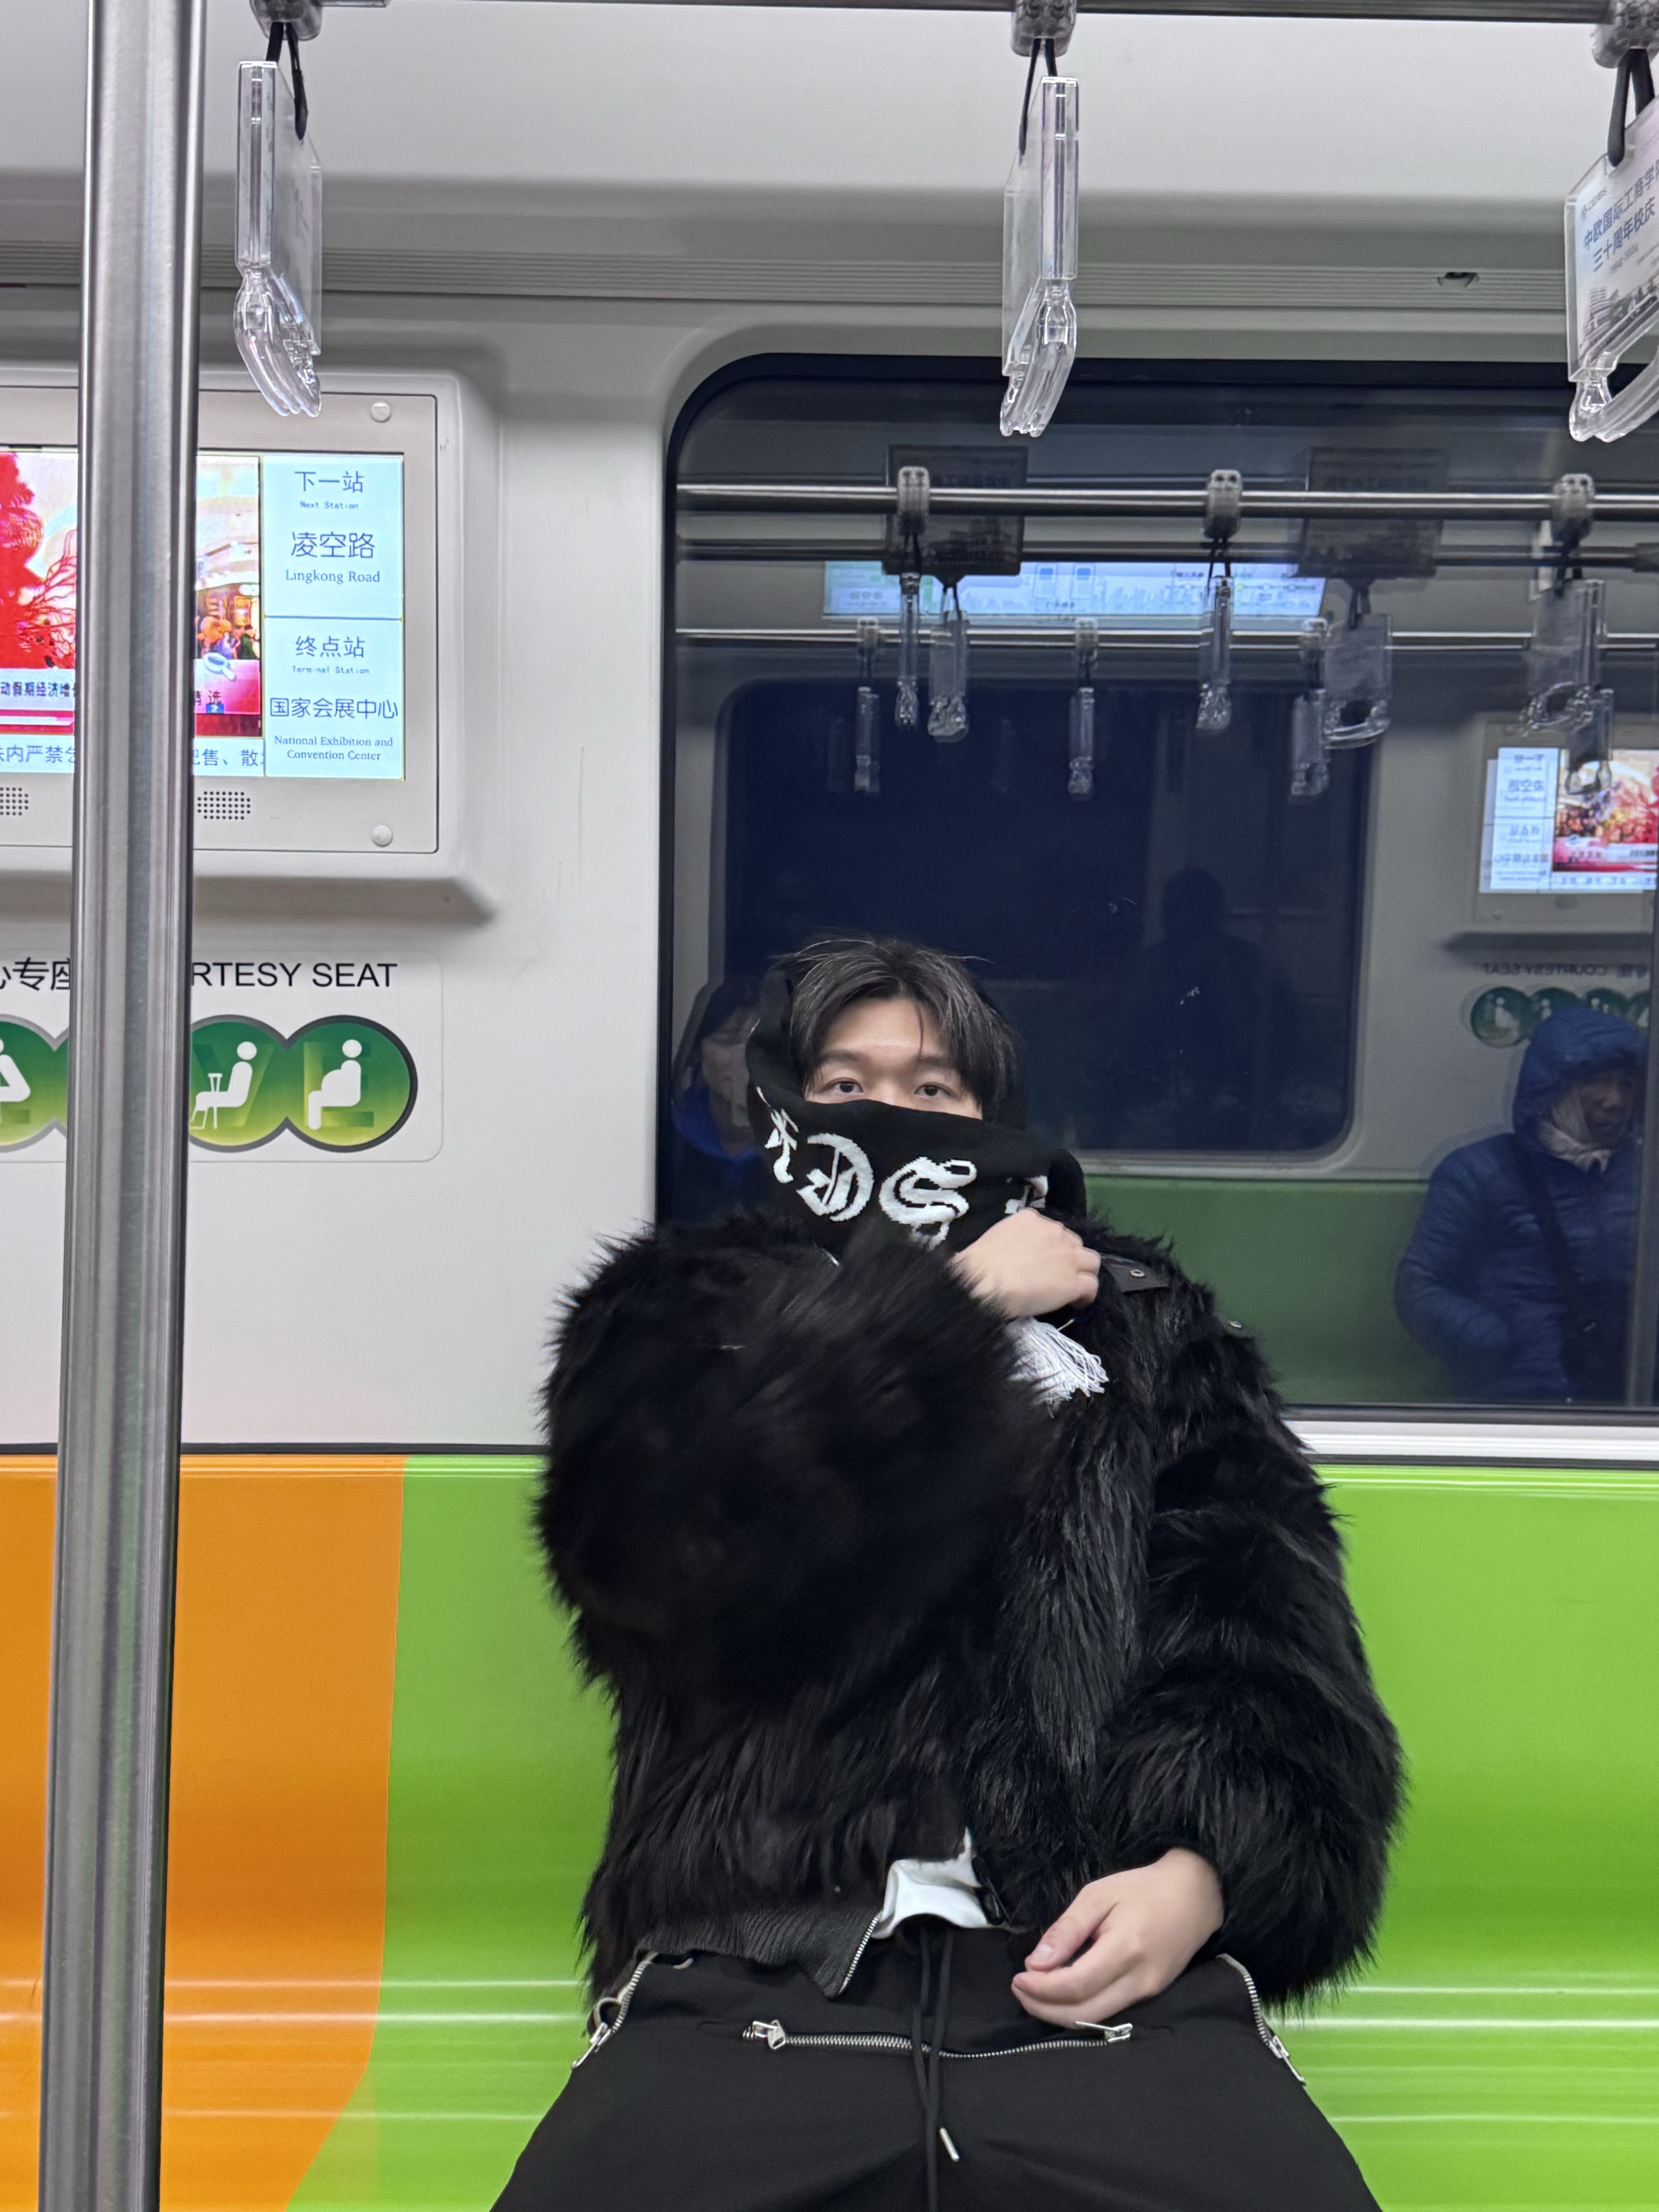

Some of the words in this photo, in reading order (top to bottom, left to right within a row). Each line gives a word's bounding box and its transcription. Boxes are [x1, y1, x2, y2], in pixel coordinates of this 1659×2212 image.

[1594, 196, 1655, 272] 三十周年校庆
[294, 471, 364, 493] 下一站
[325, 501, 359, 509] Station
[291, 531, 375, 558] 凌空路
[286, 569, 343, 584] Lingkong
[348, 571, 380, 582] Road
[295, 635, 365, 658] 终点站
[292, 665, 329, 674] Terminal
[335, 666, 369, 674] Station
[270, 697, 398, 720] 国家会展中心
[275, 735, 317, 746] National
[321, 736, 371, 746] Exhibition
[374, 737, 393, 747] and
[287, 749, 344, 760] Convention
[348, 750, 381, 760] Center
[312, 963, 398, 987] SEAT
